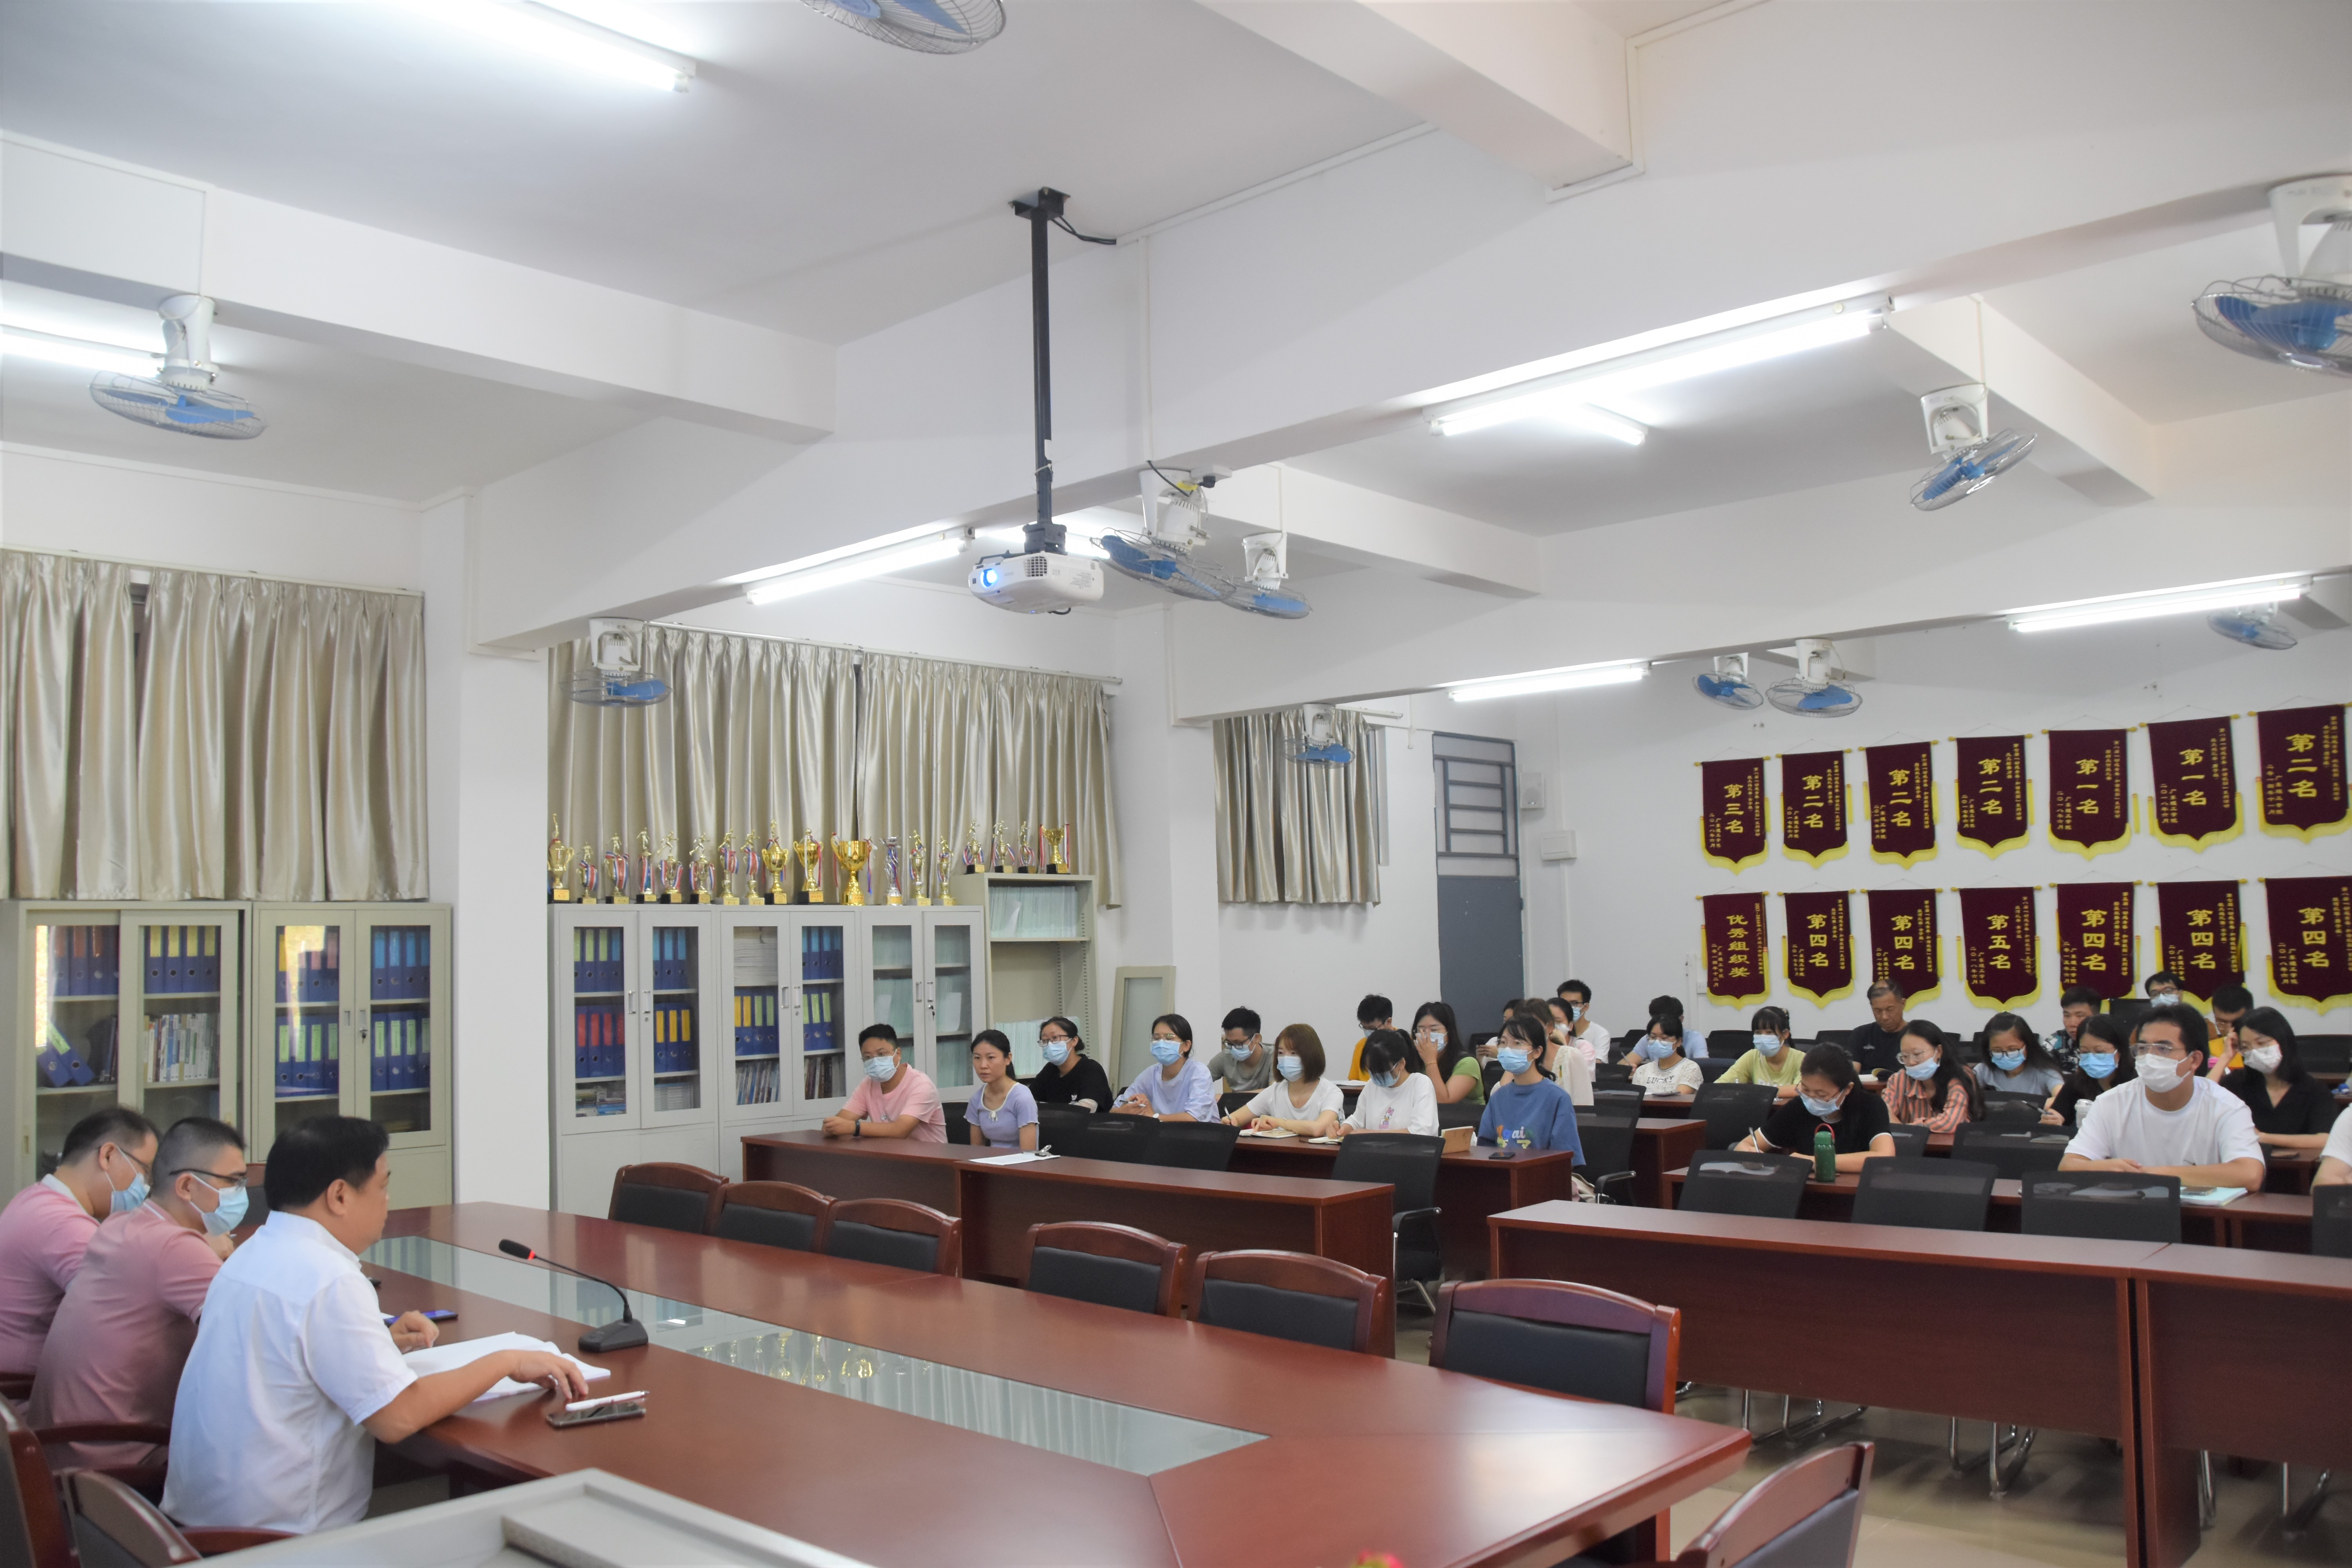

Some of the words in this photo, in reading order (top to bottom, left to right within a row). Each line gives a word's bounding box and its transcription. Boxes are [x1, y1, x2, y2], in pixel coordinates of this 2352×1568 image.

[1978, 758, 2003, 815] 第二名
[2075, 759, 2100, 814] 第一名
[2179, 748, 2207, 806] 第一名
[2285, 734, 2318, 798] 第二名
[1724, 784, 1744, 833] 第三名
[1802, 775, 1824, 828] 第二名
[1888, 769, 1913, 827] 第二名
[1726, 915, 1750, 978] 优秀组织奖
[1806, 914, 1829, 967] 第四名
[1891, 915, 1915, 970] 第四名
[1987, 915, 2011, 969] 第五名
[2081, 909, 2108, 971] 第四名
[2186, 909, 2216, 969] 第四名
[2298, 907, 2330, 967] 第四名
[1646, 1076, 1674, 1084] LUCKY
